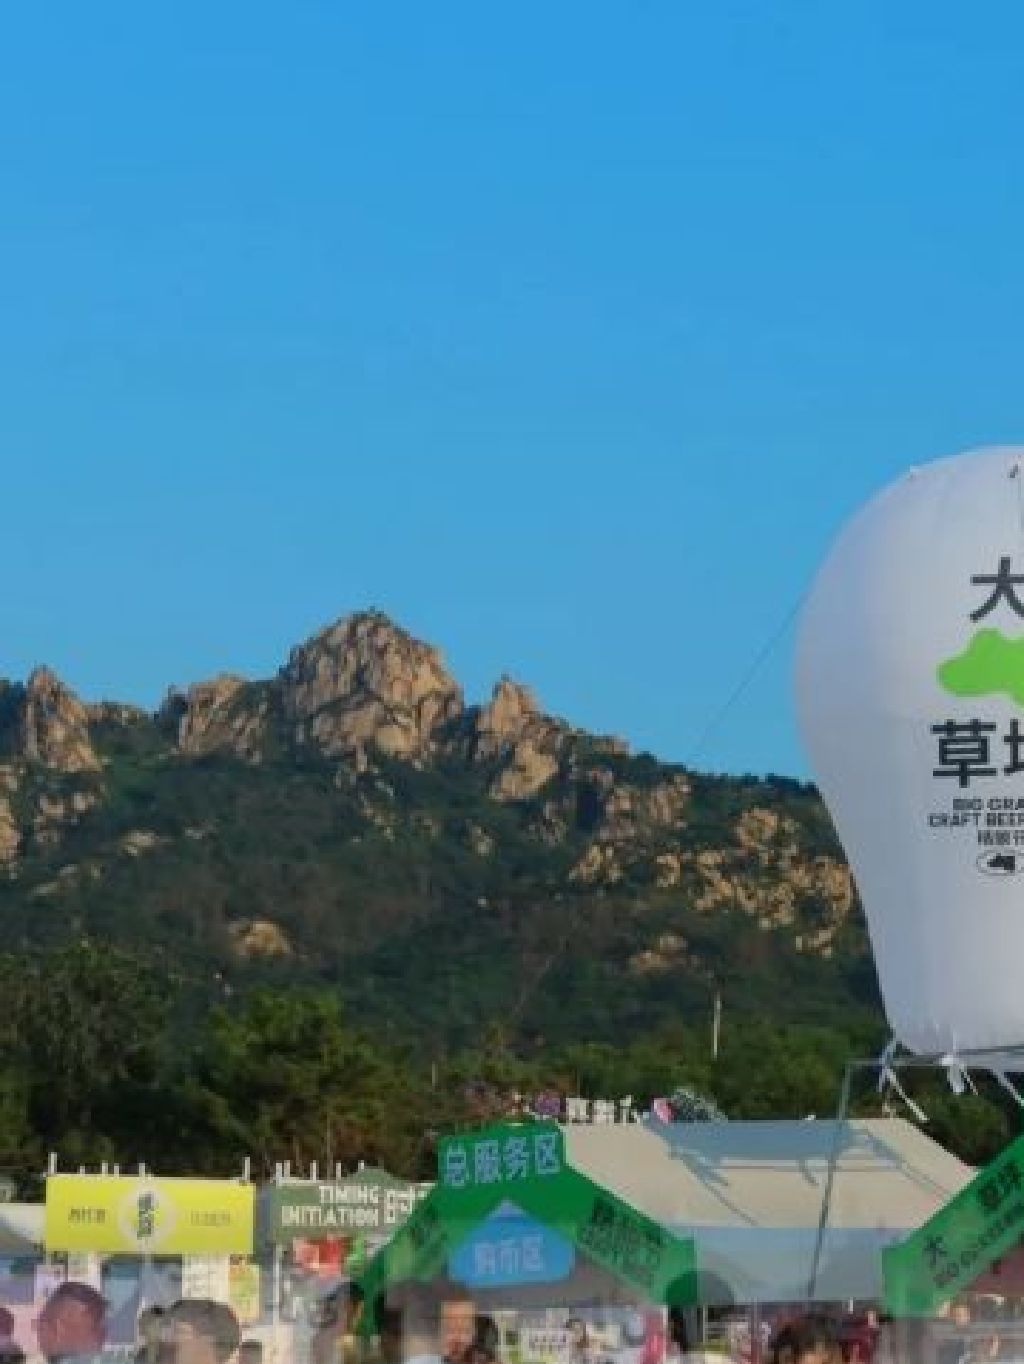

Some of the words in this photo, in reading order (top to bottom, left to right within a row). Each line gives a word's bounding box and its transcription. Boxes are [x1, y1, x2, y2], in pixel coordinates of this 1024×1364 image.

[928, 812, 981, 828] CRAFT
[443, 1130, 562, 1188] 总服务区
[318, 1184, 379, 1205] TIMING
[280, 1205, 379, 1227] INITIATION
